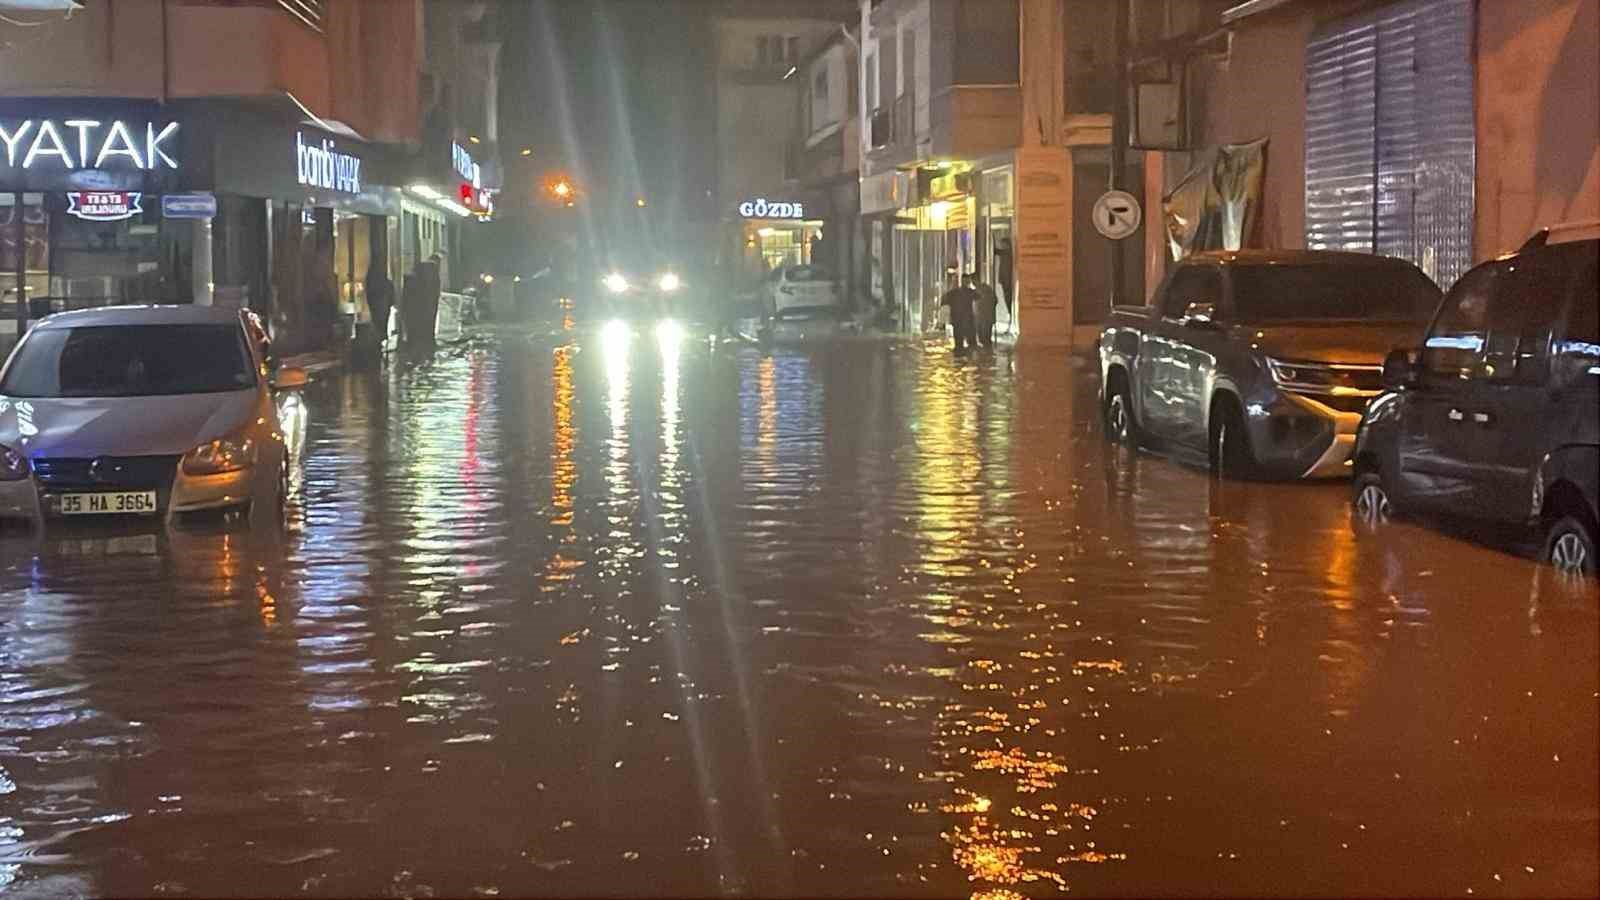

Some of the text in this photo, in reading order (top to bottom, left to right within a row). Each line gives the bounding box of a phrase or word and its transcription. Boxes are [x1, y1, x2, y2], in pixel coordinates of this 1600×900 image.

[0, 120, 179, 168] YATAK
[297, 131, 361, 193] bambi YATAK
[740, 199, 803, 218] GÖZDE
[63, 494, 153, 512] 35 HA 3664
